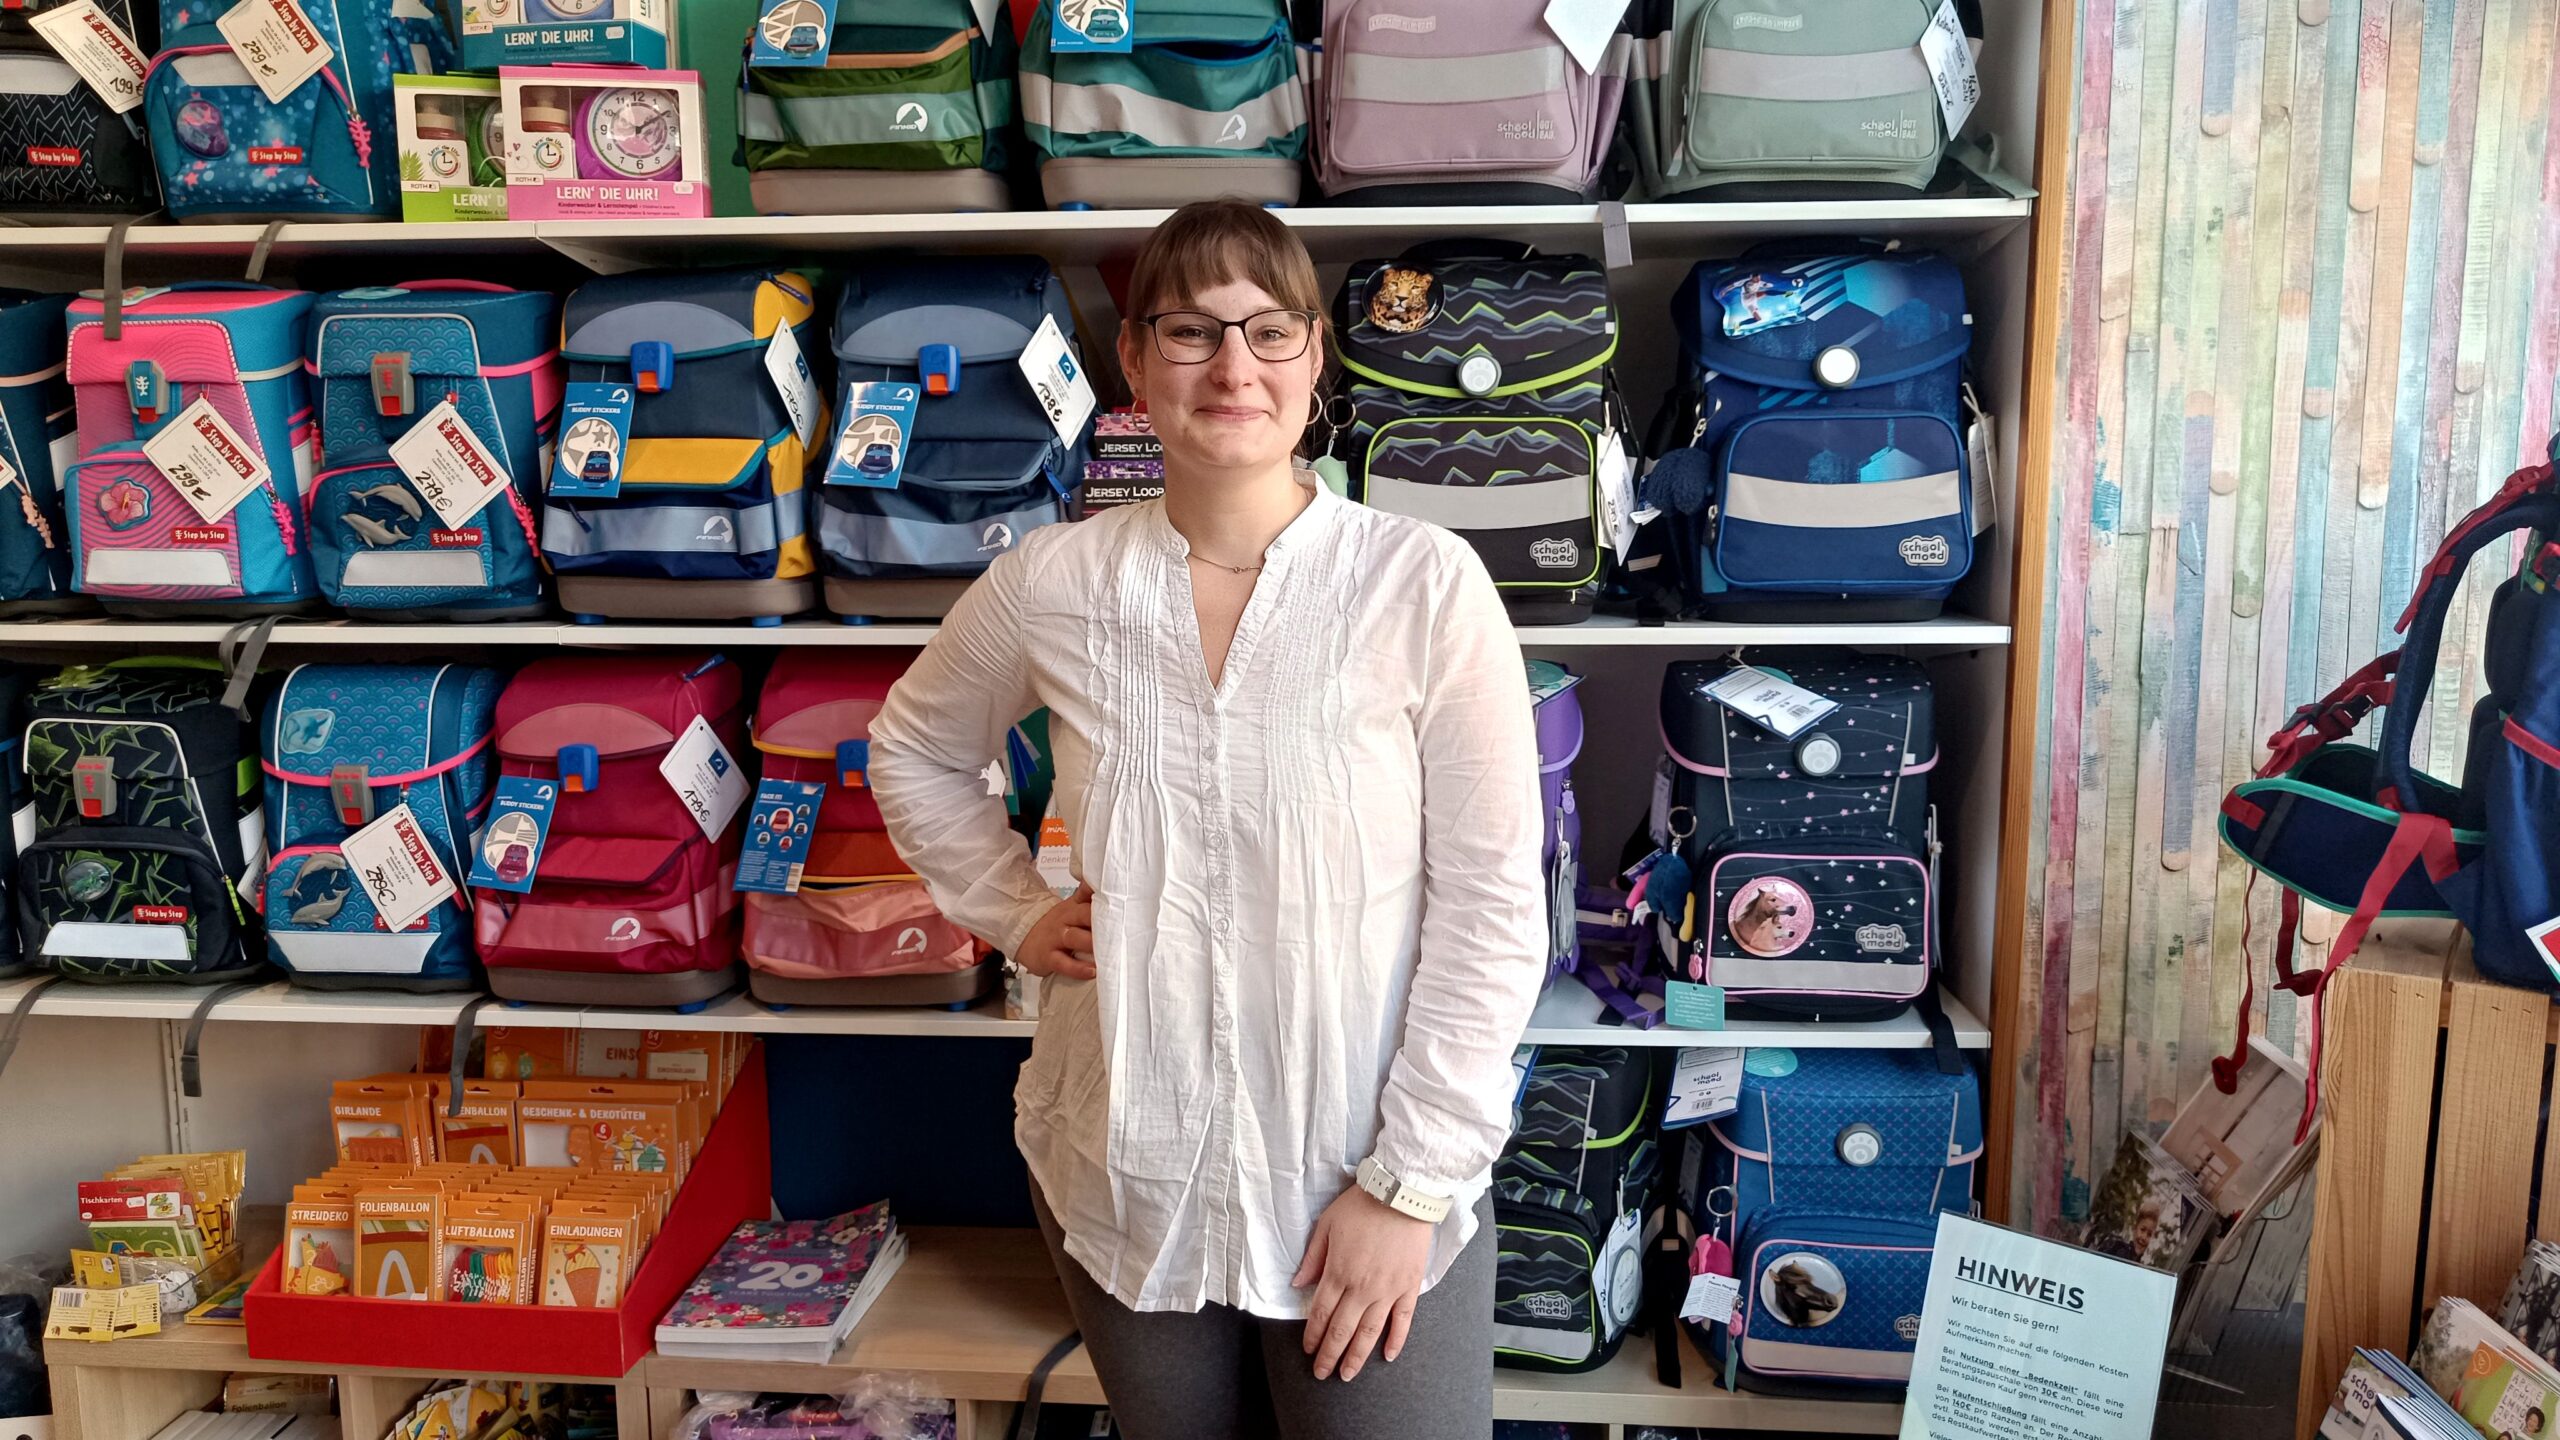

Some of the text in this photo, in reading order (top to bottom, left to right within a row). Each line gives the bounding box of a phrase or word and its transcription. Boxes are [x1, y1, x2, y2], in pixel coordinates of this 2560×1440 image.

[278, 3, 312, 49] Step by Step
[542, 31, 561, 44] DIE
[564, 28, 594, 43] UHR!
[98, 28, 117, 47] Step
[116, 45, 128, 59] by
[125, 57, 144, 76] Step
[1497, 121, 1532, 133] school
[1860, 120, 1895, 131] school
[1504, 126, 1535, 140] mood
[1867, 127, 1899, 139] mood
[39, 151, 76, 163] Step by Step
[259, 150, 298, 162] Step by Step
[599, 187, 622, 200] DIE
[625, 187, 659, 201] UHR!
[206, 428, 248, 475] Step by Step
[1099, 442, 1143, 453] JERSEY
[449, 433, 489, 481] Step by Step
[168, 464, 200, 488] 299
[1085, 486, 1131, 498] JERSEY
[183, 530, 226, 540] Step by Step
[440, 532, 479, 543] Step by Step
[1533, 543, 1570, 555] school
[1903, 541, 1942, 553] school
[1541, 551, 1574, 563] mood
[1910, 550, 1944, 562] mood
[403, 832, 436, 881] Step by Step
[144, 908, 183, 920] Step by Step
[1859, 929, 1899, 941] school
[1866, 936, 1901, 948] mood
[335, 1105, 382, 1118] GIRLANDE
[522, 1106, 647, 1120] GESCHENK- & DEKOTÜTEN
[80, 1196, 123, 1205] Tischkarten
[360, 1202, 431, 1213] FOLIENBALLON
[291, 1209, 349, 1222] STREUDEKO
[445, 1225, 515, 1239] LUFTBALLONS
[550, 1225, 623, 1239] EINLADUNGEN
[737, 1261, 824, 1291] 20
[1957, 1255, 2085, 1310] HINWEIS
[1527, 1295, 1564, 1308] school
[1533, 1304, 1569, 1318] mood
[1952, 1295, 2059, 1334] Wir beraten Sie gern!
[1946, 1328, 1996, 1349] Aufmerksam
[1947, 1318, 2129, 1379] Wir möchten Sie auf die folgenden Kosten
[1939, 1365, 1960, 1377] beim
[1961, 1372, 1996, 1389] späteren
[1998, 1382, 2017, 1394] Kauf
[2018, 1390, 2037, 1402] gern
[1943, 1346, 1956, 1356] Bei
[1960, 1351, 1994, 1369] Nutzung
[1999, 1365, 2020, 1376] einer
[2083, 1389, 2100, 1401] fällt
[2105, 1398, 2125, 1409] eine
[1941, 1355, 2021, 1386] Beratungspauschale
[2023, 1382, 2039, 1392] von
[2041, 1387, 2059, 1398] 30€
[2076, 1398, 2101, 1412] Diese
[2103, 1407, 2123, 1419] wird
[2350, 1373, 2376, 1401] scho
[1935, 1393, 1950, 1403] von
[1973, 1407, 1988, 1417] pro
[1990, 1410, 2022, 1427] Ranzen
[2039, 1427, 2055, 1437] Der
[1936, 1383, 2069, 1433] Bei Kaufentschließung fällt eine
[1931, 1412, 1946, 1422] des
[1953, 1409, 1985, 1425] Rabatte
[1988, 1422, 2020, 1436] werden
